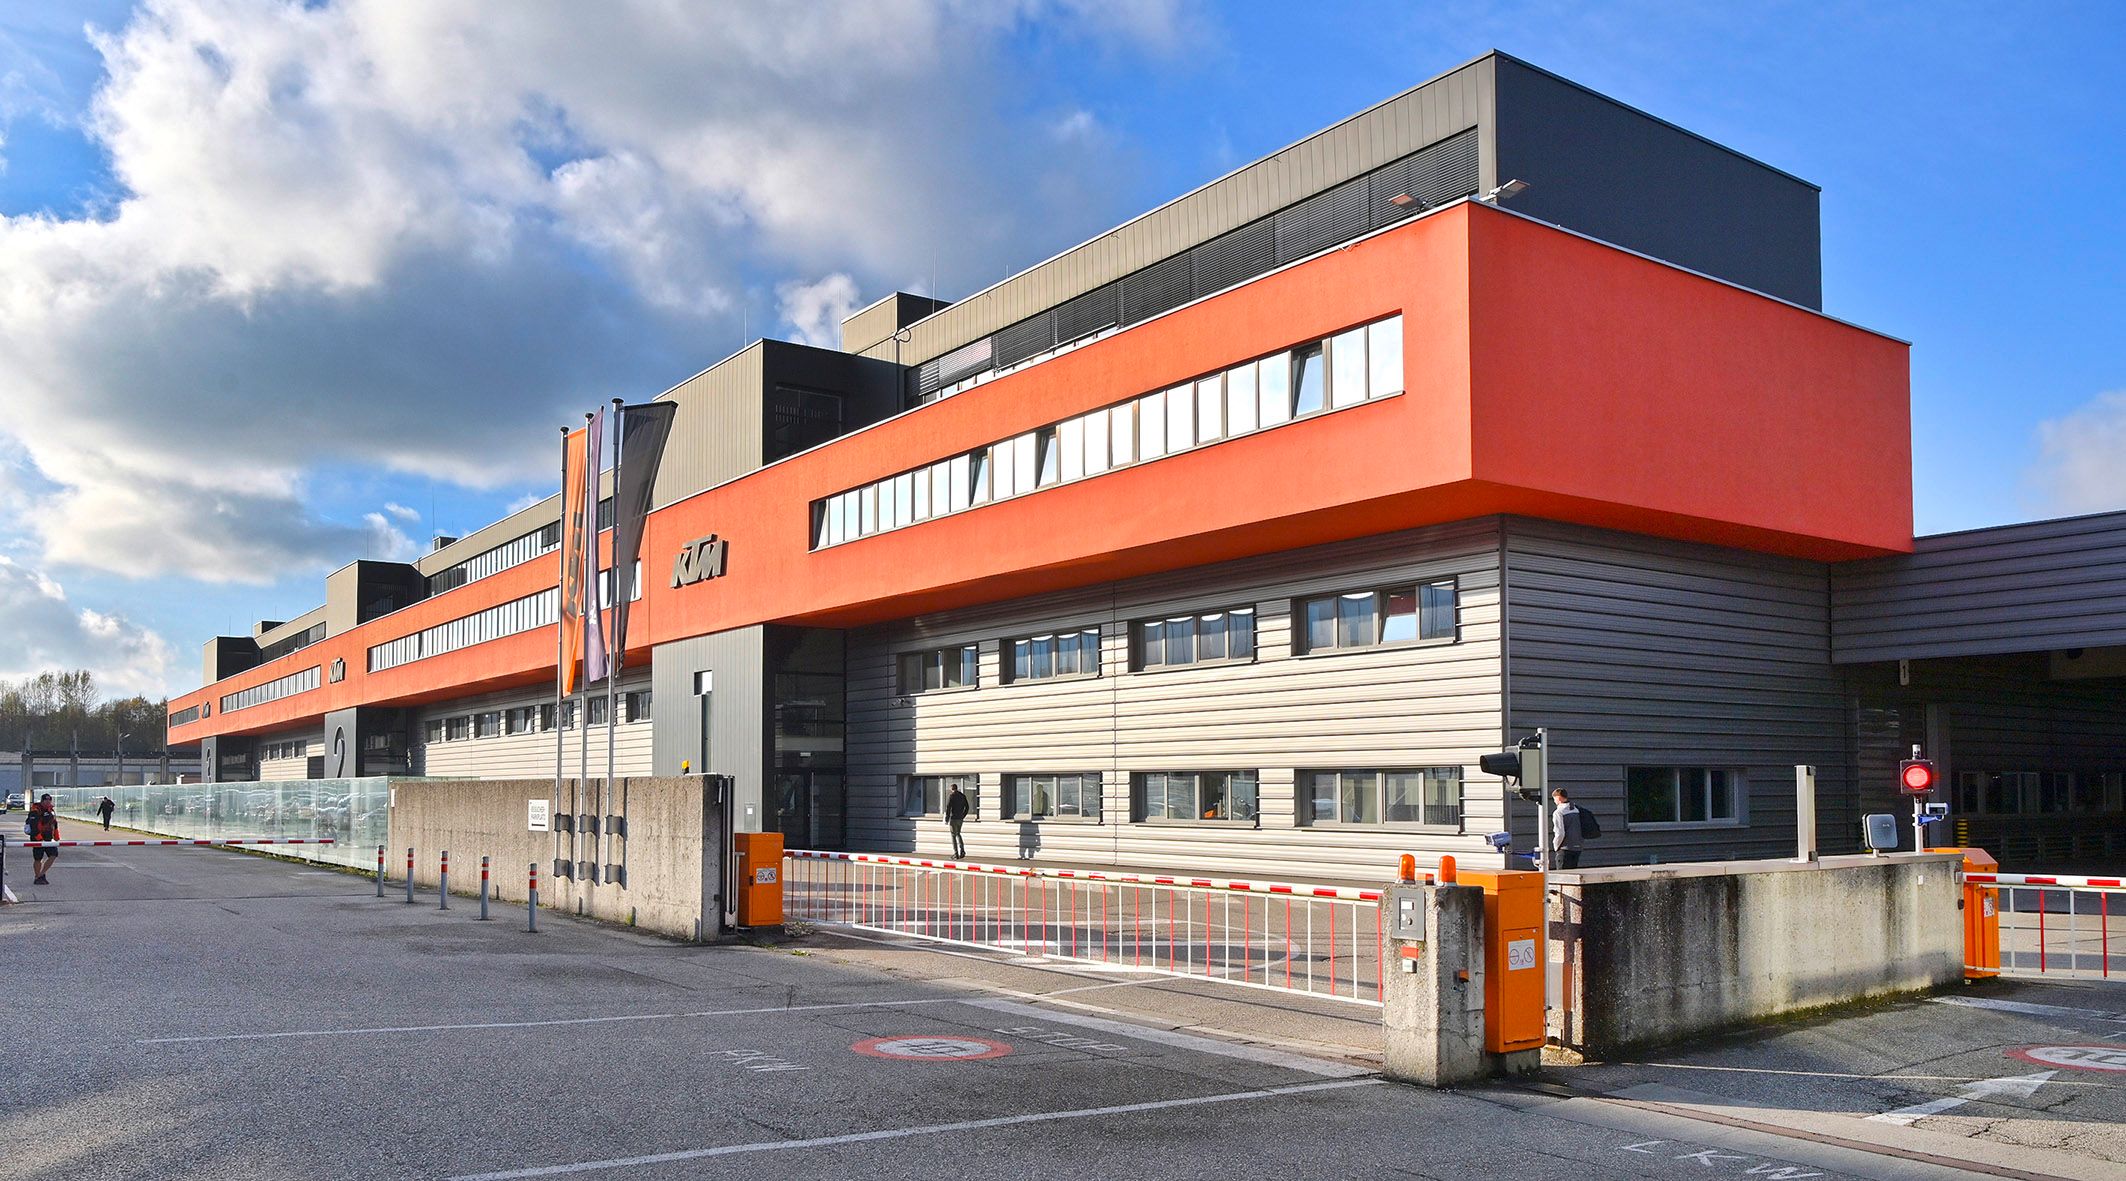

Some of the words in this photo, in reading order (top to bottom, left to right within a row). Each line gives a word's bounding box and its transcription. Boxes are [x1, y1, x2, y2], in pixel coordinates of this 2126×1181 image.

[669, 533, 729, 589] KTM
[993, 1026, 1127, 1051] STOP
[703, 1049, 810, 1072] PKW
[1617, 1140, 1824, 1180] LKW
